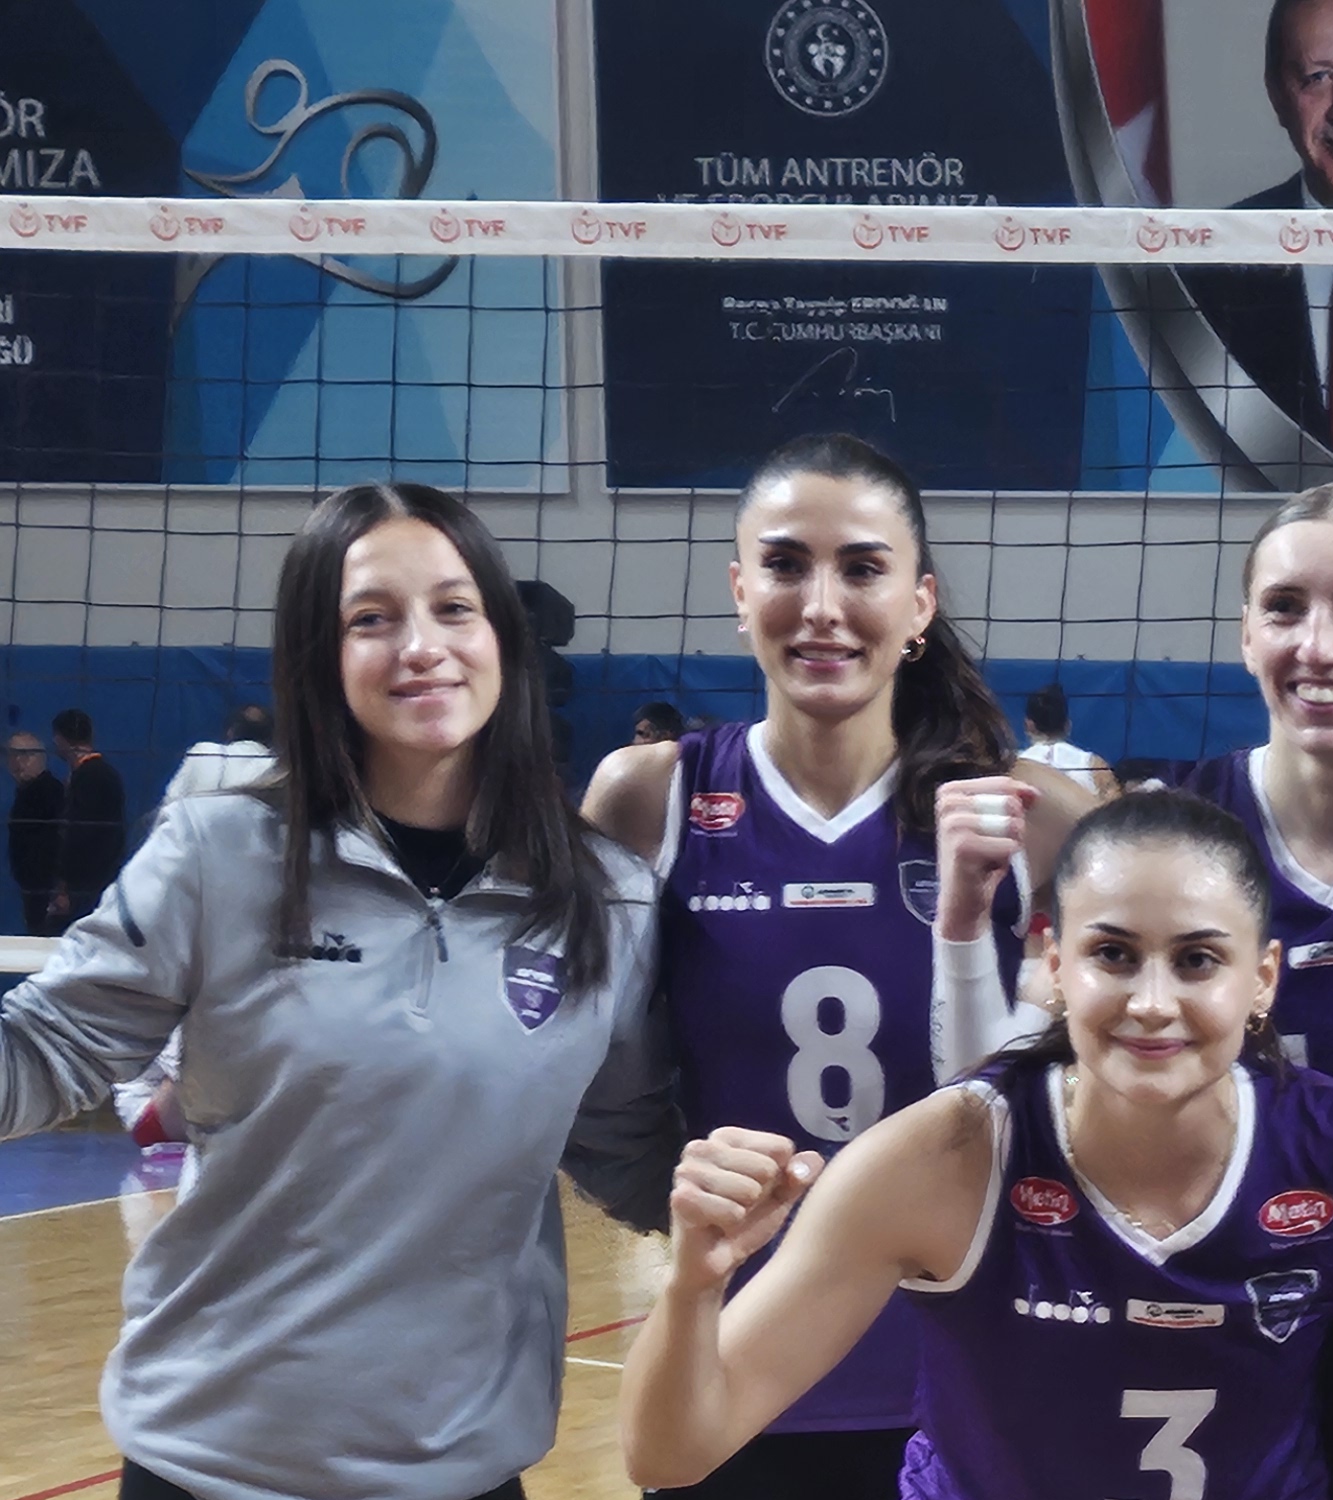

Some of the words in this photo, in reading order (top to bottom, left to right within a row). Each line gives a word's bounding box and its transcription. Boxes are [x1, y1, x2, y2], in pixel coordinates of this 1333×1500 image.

[694, 152, 770, 187] TÜM
[781, 152, 965, 187] ANTRENÖR
[44, 214, 88, 232] TVF
[324, 215, 366, 234] TVF
[465, 218, 506, 236] TVF
[606, 220, 647, 238] TVF
[746, 222, 788, 240] TVF
[888, 224, 930, 242] TVF
[1029, 226, 1070, 244] TVF
[1169, 227, 1212, 245] TVF
[780, 965, 886, 1143] 8
